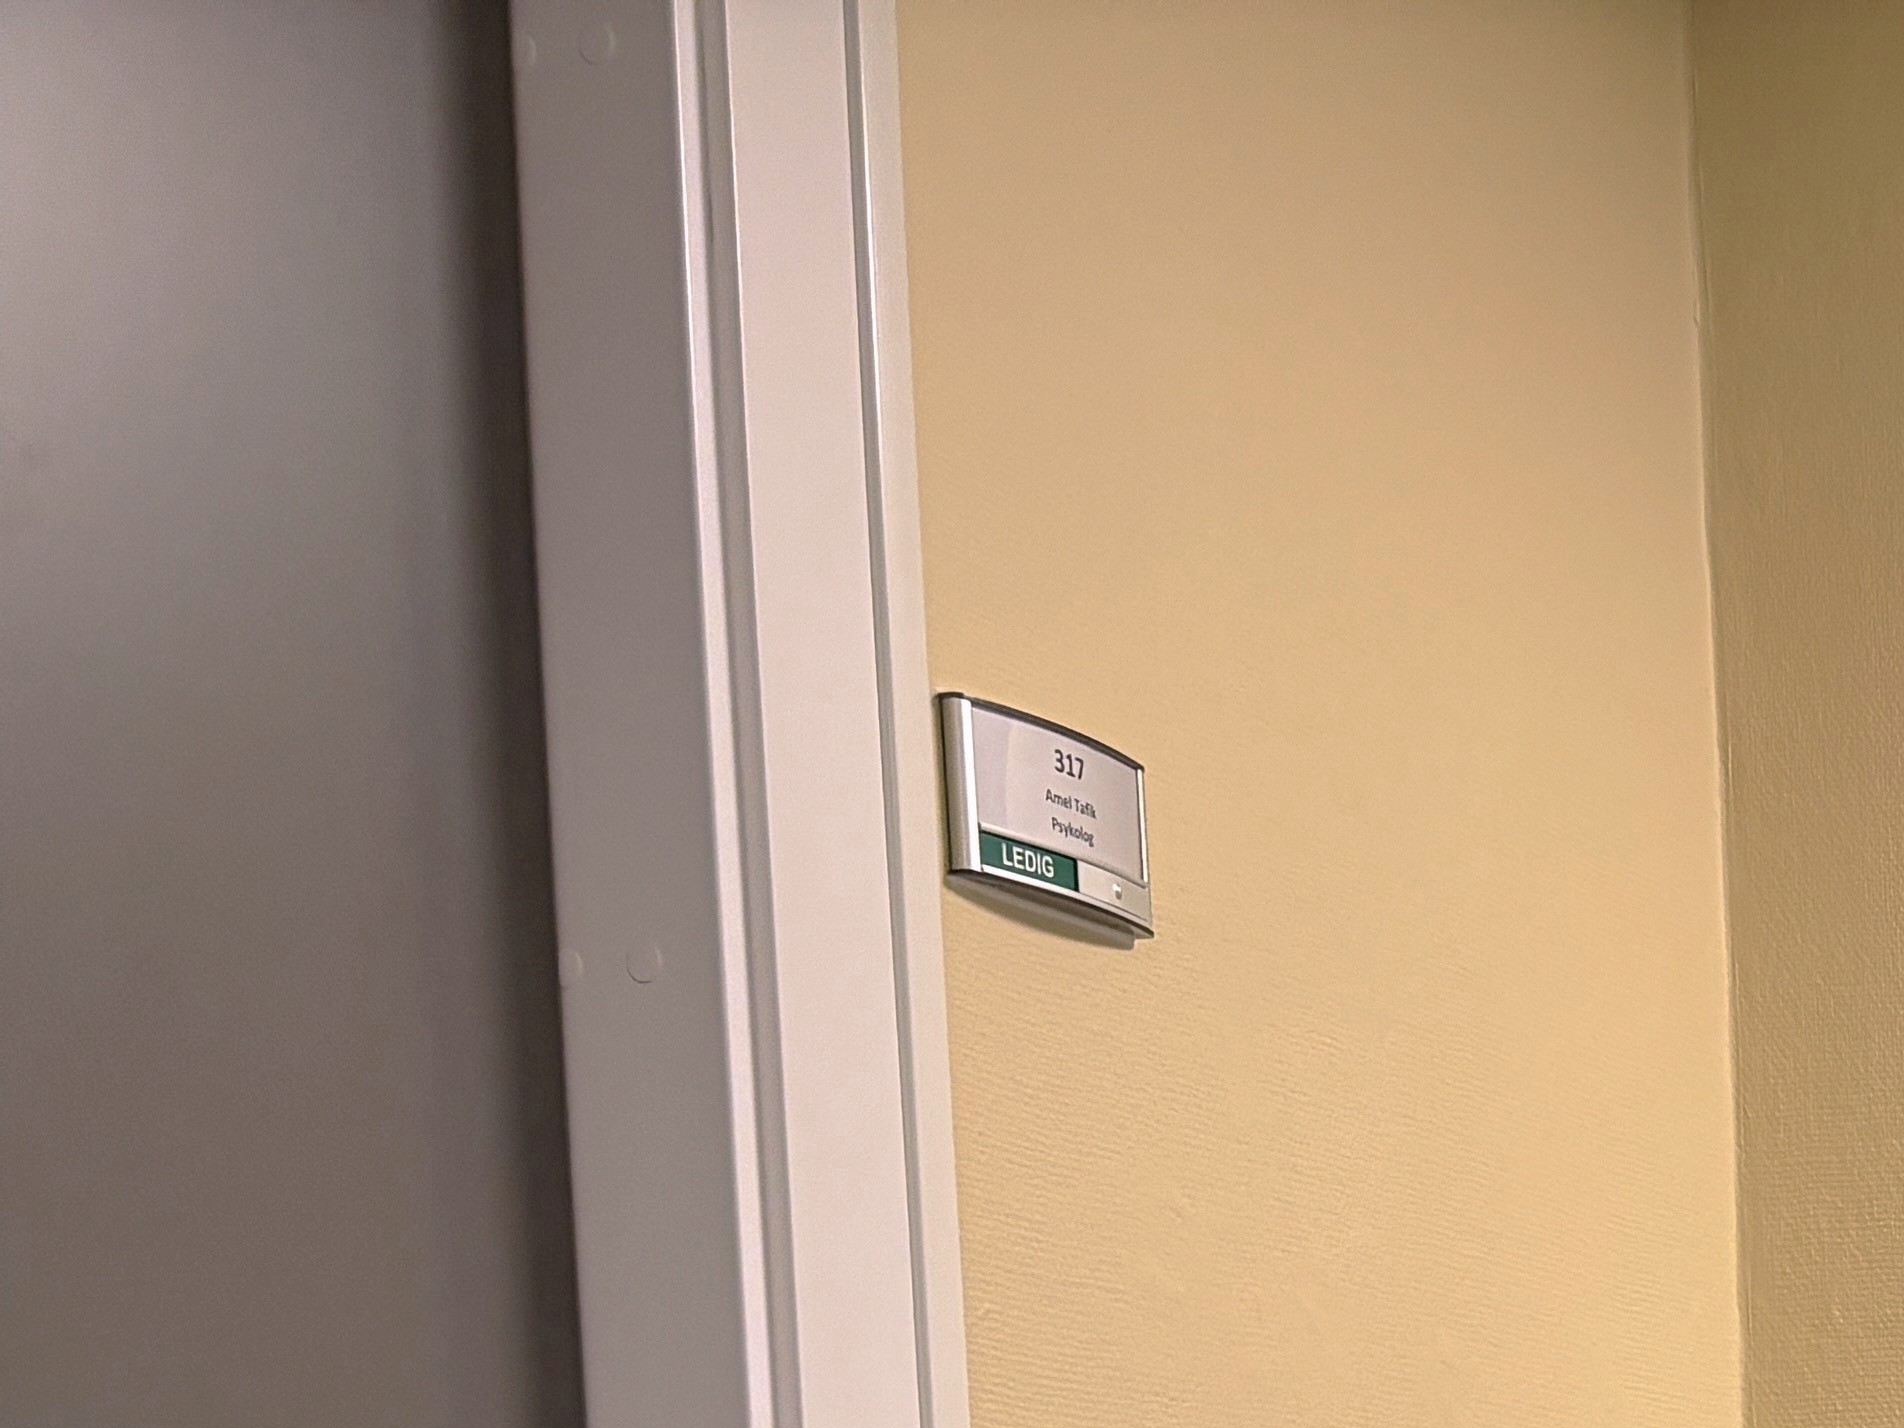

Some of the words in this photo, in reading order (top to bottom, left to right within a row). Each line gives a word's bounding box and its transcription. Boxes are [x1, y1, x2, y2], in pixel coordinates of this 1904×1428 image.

[1054, 749, 1084, 780] 317
[1051, 816, 1094, 847] Psykolog
[1002, 843, 1054, 878] LEDIG
